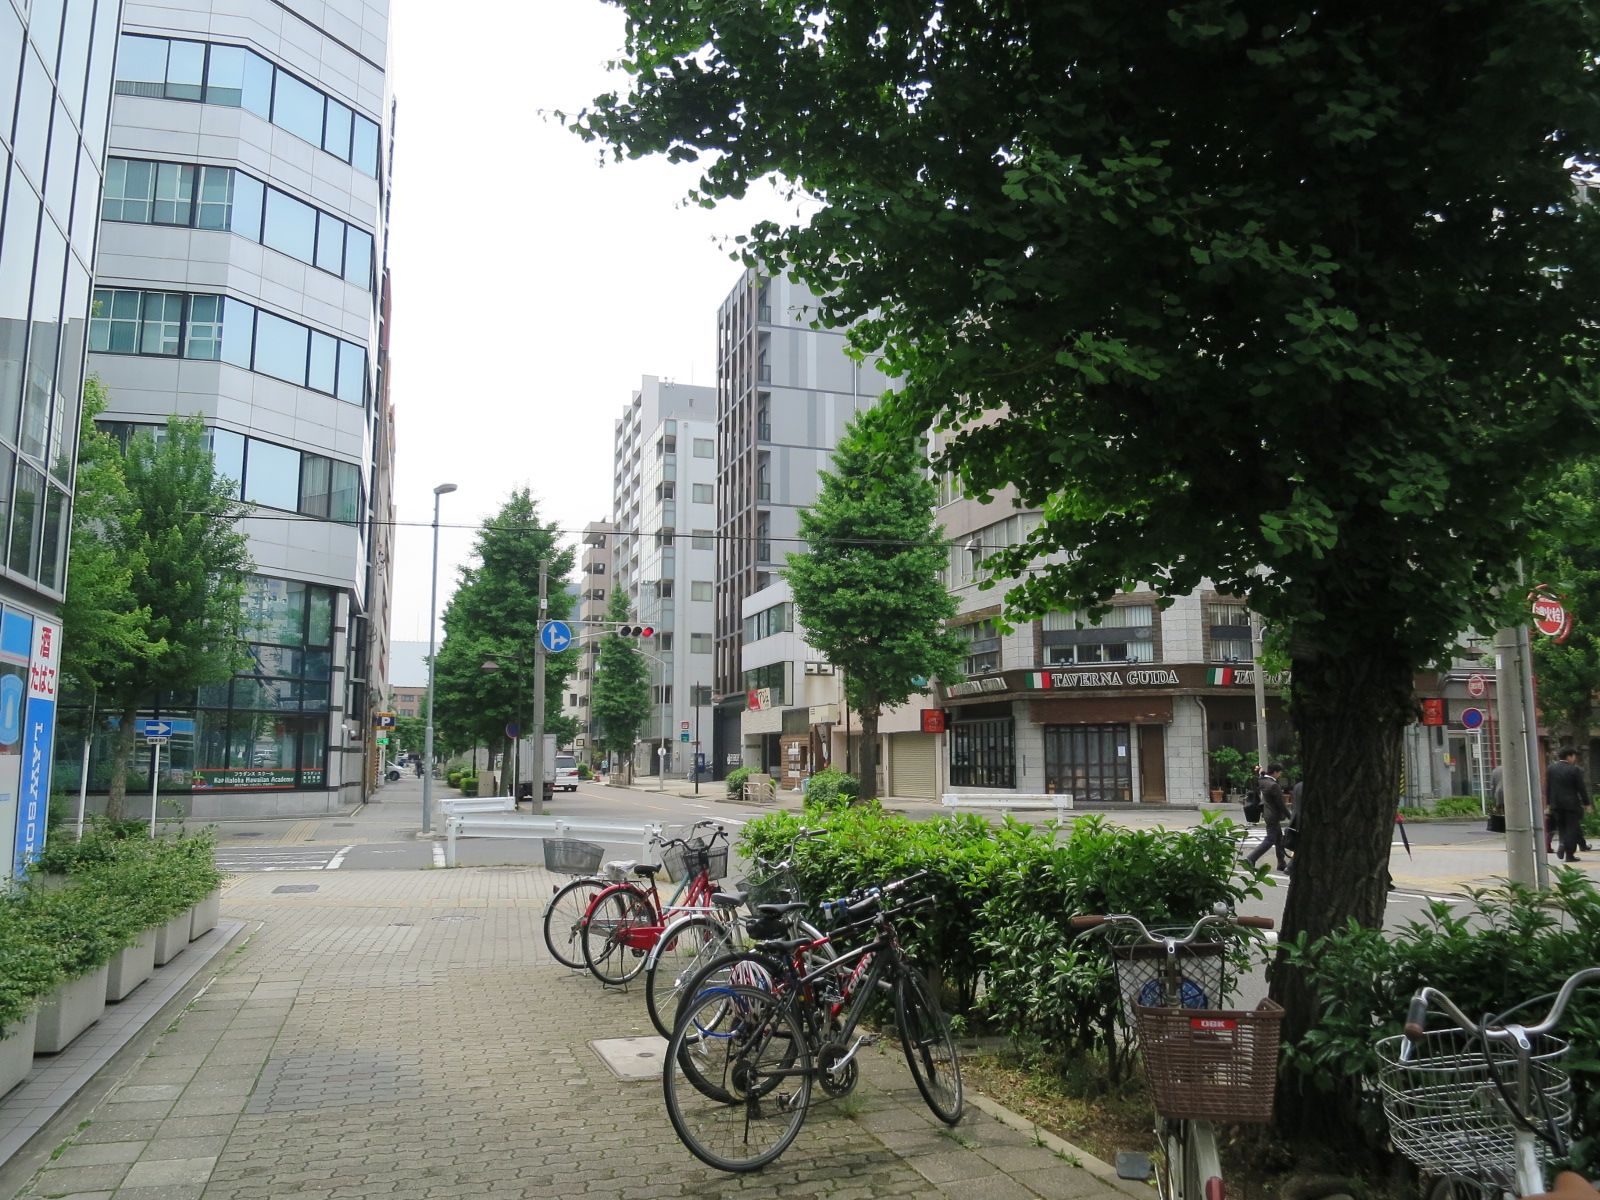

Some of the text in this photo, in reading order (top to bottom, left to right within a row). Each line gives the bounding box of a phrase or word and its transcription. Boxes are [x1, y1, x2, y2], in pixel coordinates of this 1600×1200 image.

[40, 626, 52, 659] 酒
[31, 662, 55, 694] たばこ
[1051, 669, 1180, 687] TAVERNA GUIDA
[381, 716, 391, 727] P
[271, 775, 295, 783] Academy
[24, 722, 44, 868] LAWSON
